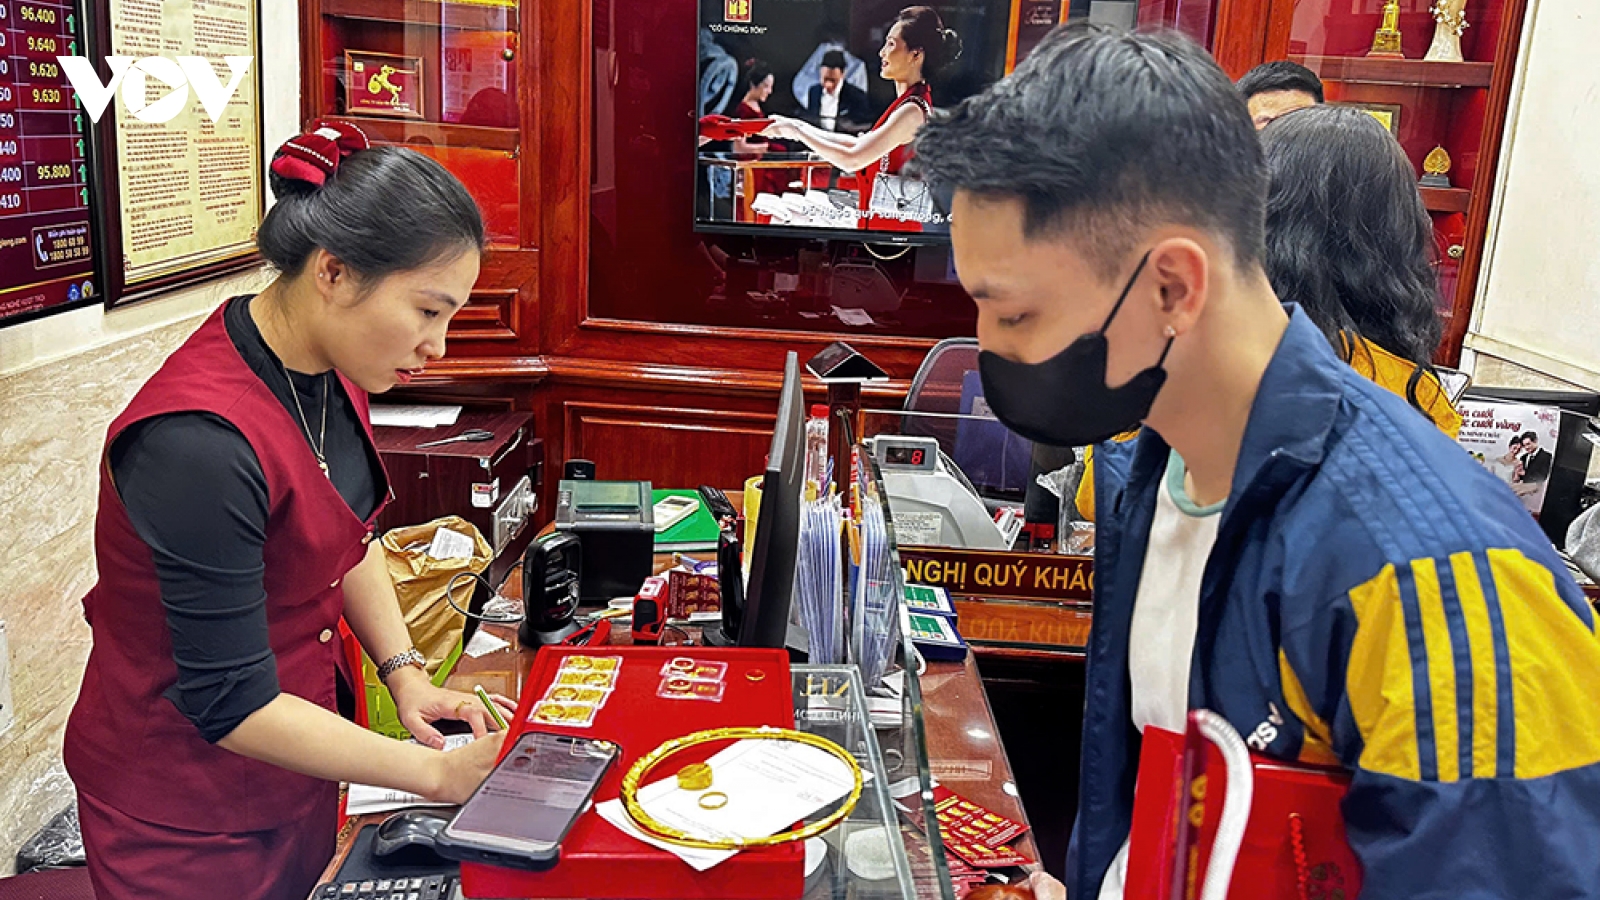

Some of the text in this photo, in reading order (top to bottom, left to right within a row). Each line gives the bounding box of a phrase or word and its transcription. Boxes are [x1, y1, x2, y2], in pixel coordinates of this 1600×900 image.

[20, 6, 55, 24] 96.400
[27, 36, 56, 52] 9.640
[29, 62, 58, 78] 9.620
[32, 89, 60, 103] 9.630
[37, 164, 71, 180] 95.800
[911, 450, 923, 465] 8
[905, 558, 967, 589] NGHỊ
[974, 559, 1028, 588] QUÝ
